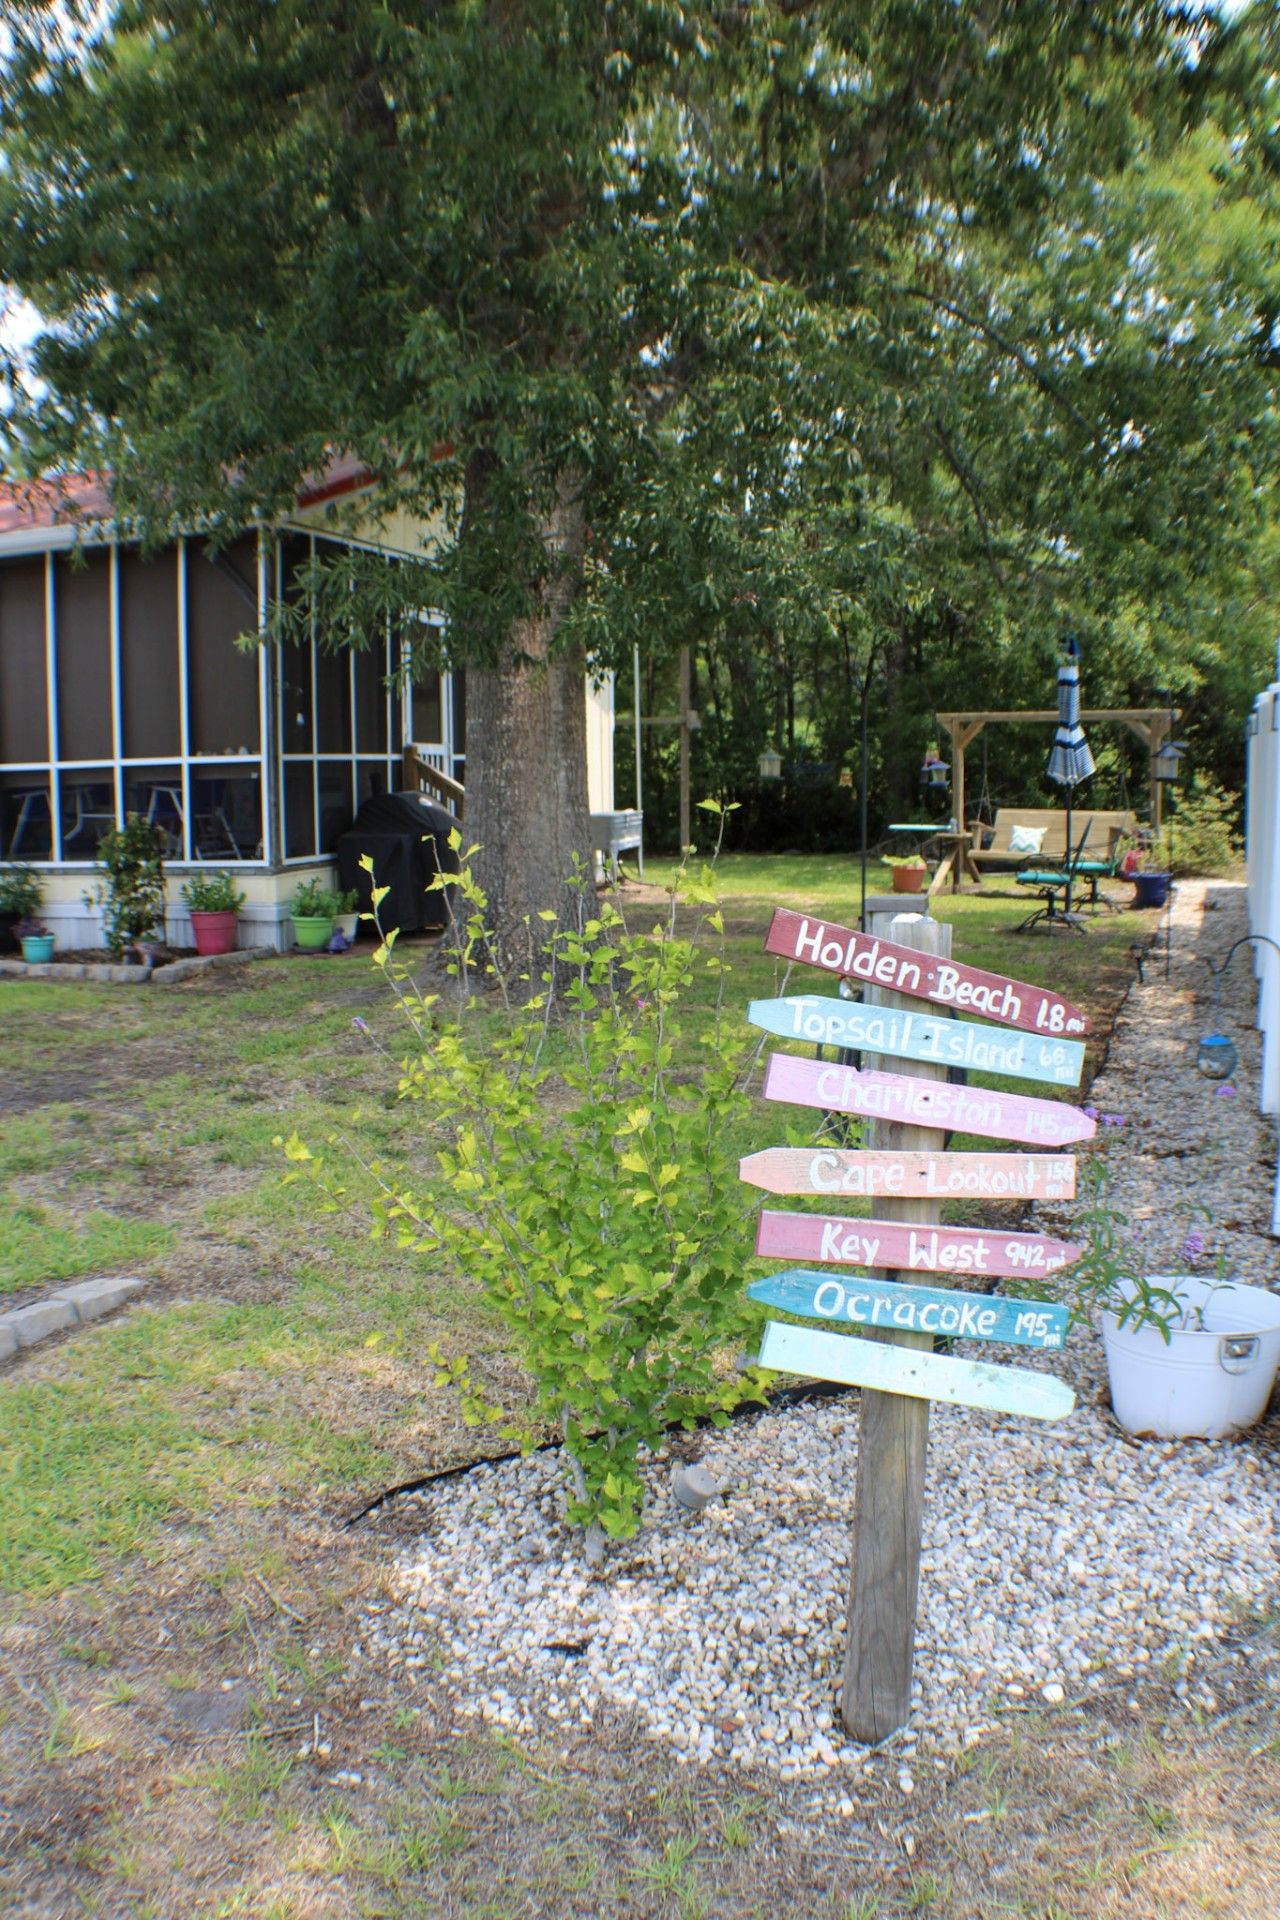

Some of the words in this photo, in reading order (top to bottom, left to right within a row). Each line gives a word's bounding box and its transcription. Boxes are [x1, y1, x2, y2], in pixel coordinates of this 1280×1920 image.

[795, 919, 921, 990] Holden
[929, 965, 1022, 1020] Beach
[1066, 1015, 1086, 1033] mi
[785, 998, 913, 1051] Topsail
[919, 1022, 1025, 1071] Island
[817, 1068, 1002, 1129] Charleston
[1024, 1110, 1060, 1137] 145
[1061, 1119, 1083, 1139] mi
[809, 1153, 905, 1195] Cape
[926, 1160, 1040, 1195] Lookout
[820, 1222, 880, 1266] Key
[908, 1231, 990, 1269] West
[1005, 1241, 1046, 1269] 942
[1046, 1249, 1066, 1271] mi
[1014, 1312, 1054, 1339] 195
[1043, 1325, 1061, 1347] mi
